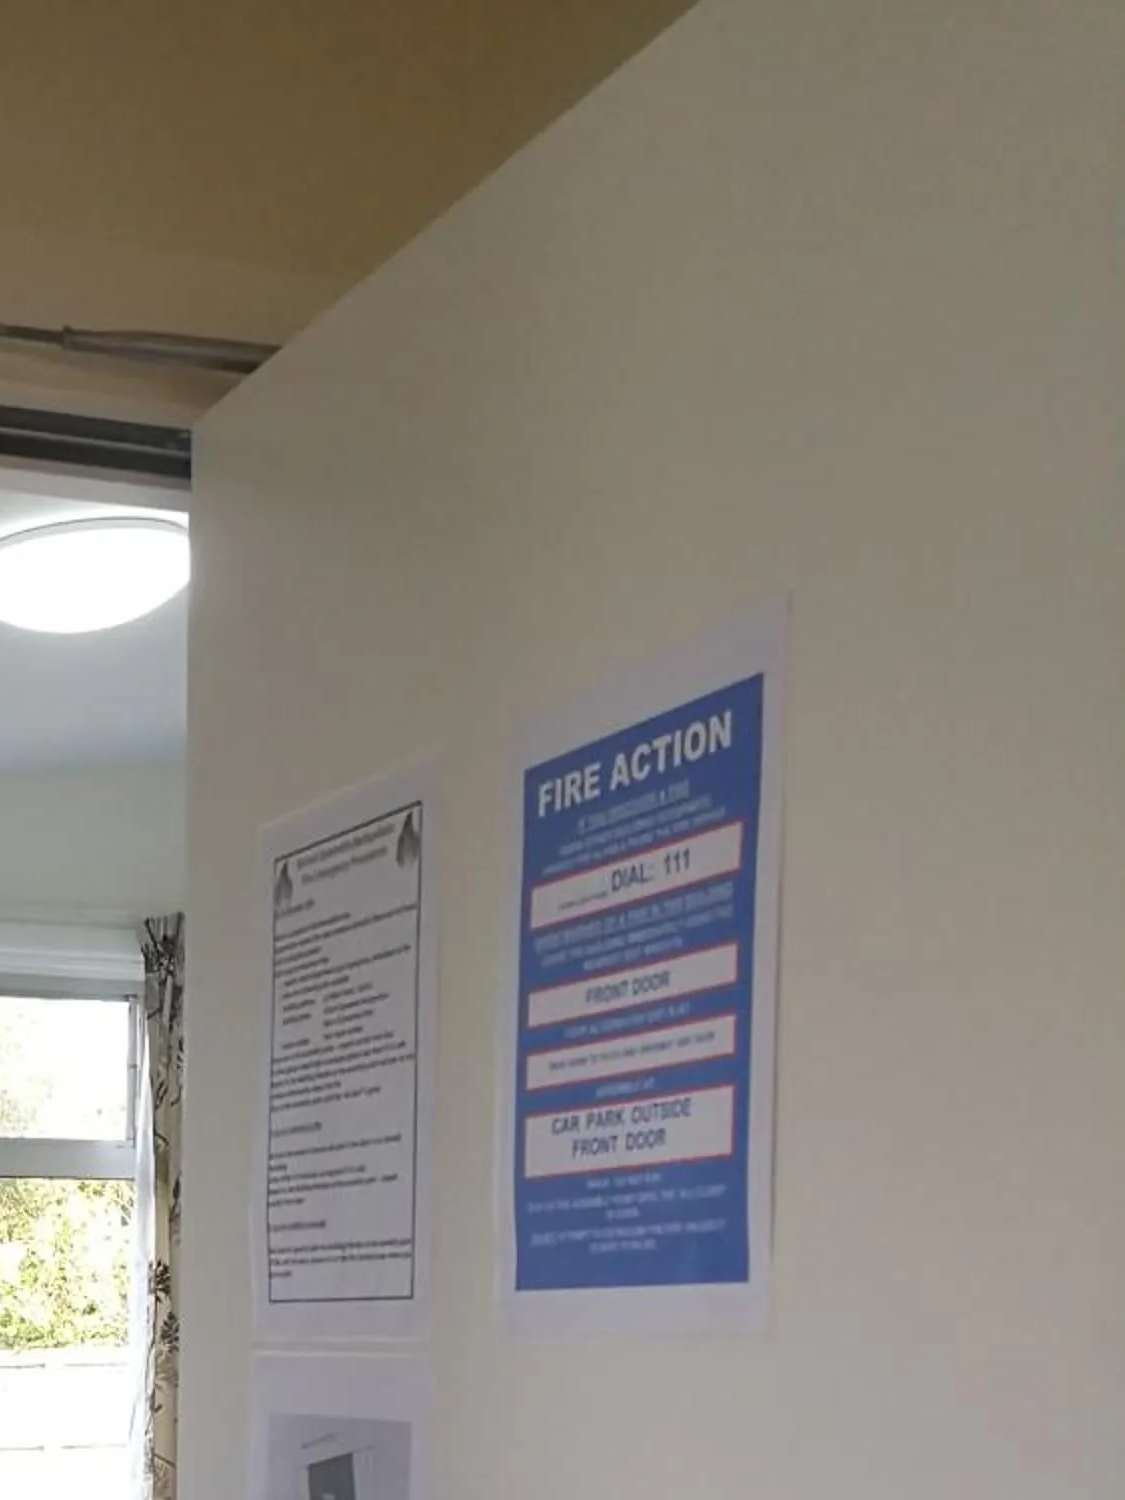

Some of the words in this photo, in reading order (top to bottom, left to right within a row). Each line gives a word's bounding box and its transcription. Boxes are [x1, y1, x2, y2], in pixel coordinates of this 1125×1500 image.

[537, 762, 601, 817] FIRE
[610, 710, 733, 791] ACTION
[663, 847, 691, 876] 111
[586, 976, 630, 1004] FRONT
[632, 971, 671, 996] DOOR
[551, 1111, 580, 1135] CAR
[586, 1106, 625, 1131] PARK
[631, 1098, 691, 1123] OUTSIDE
[572, 1134, 618, 1159] FRONT
[625, 1128, 666, 1150] DOOR
